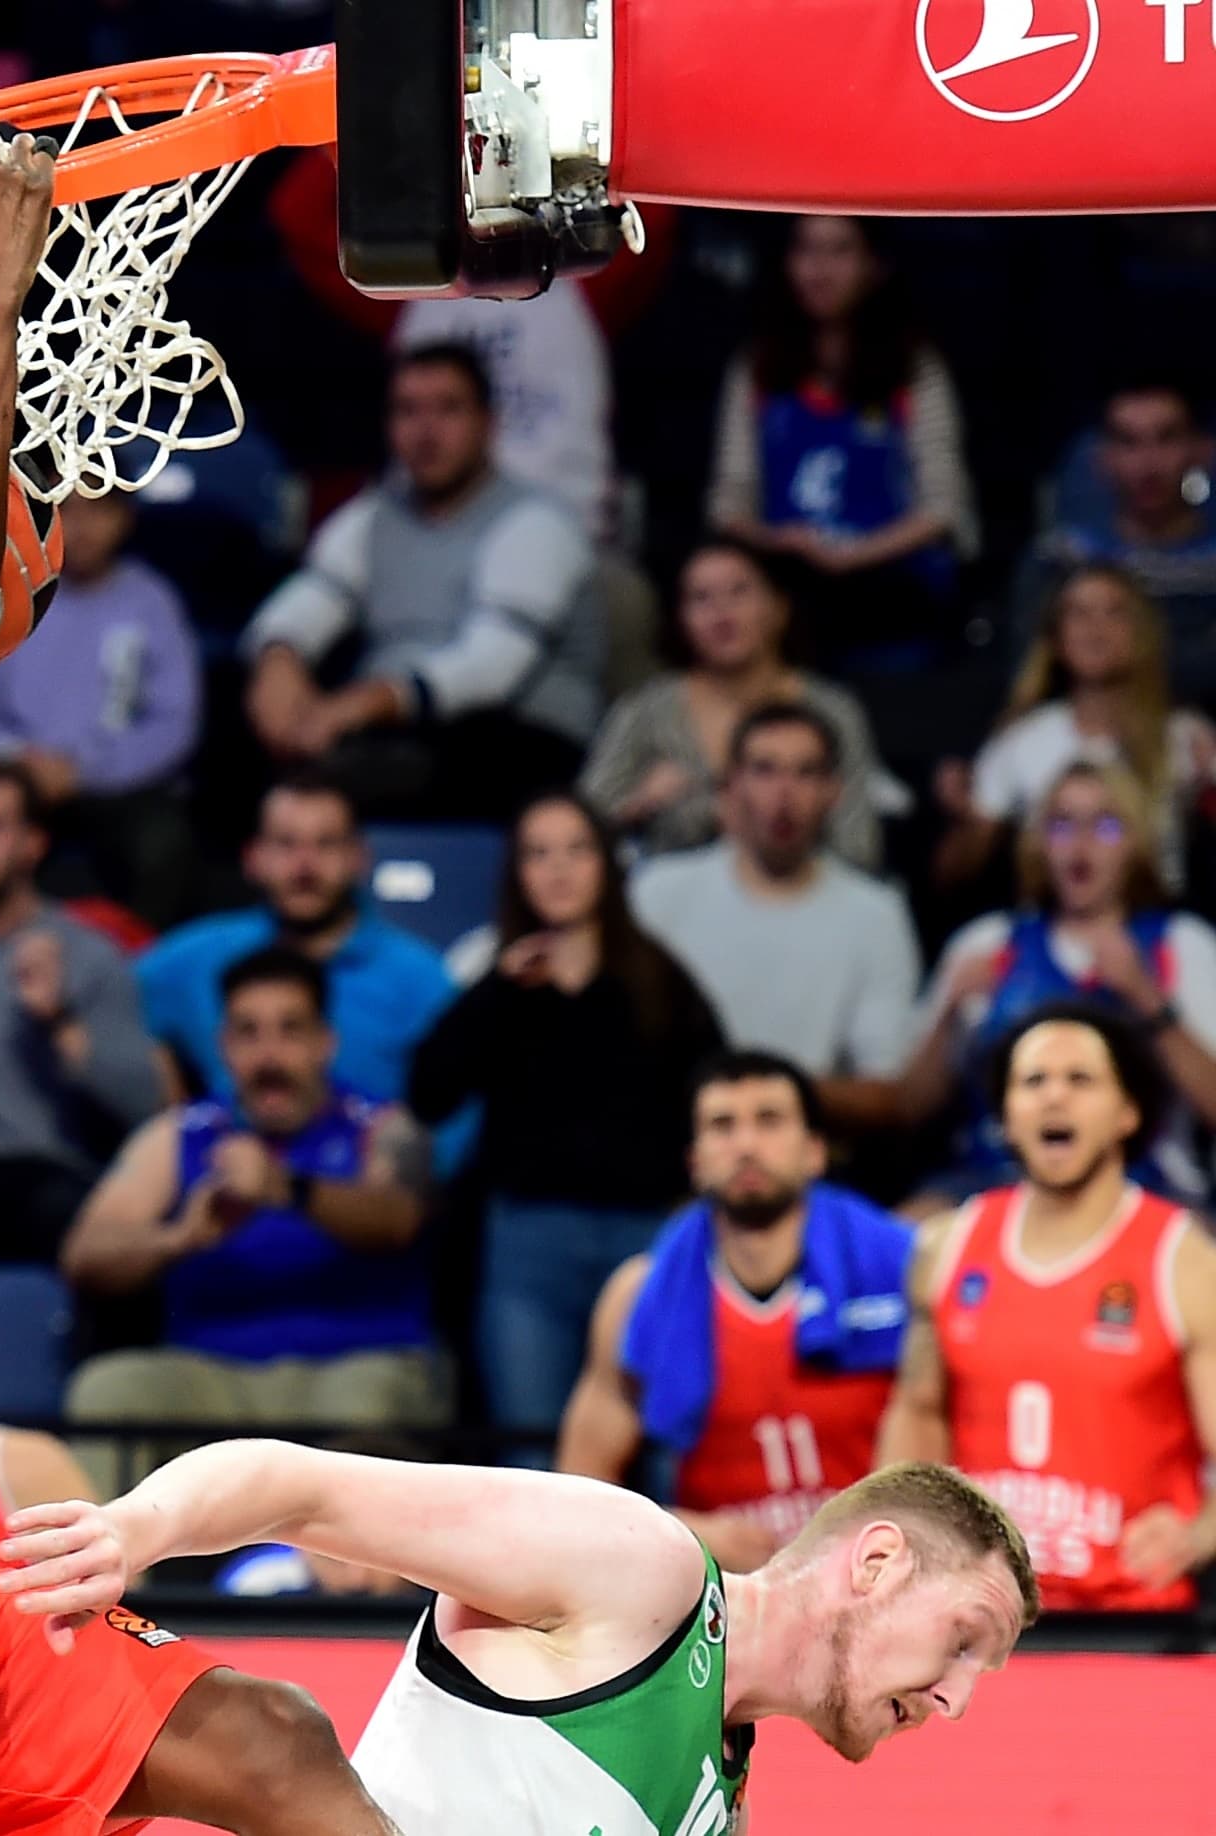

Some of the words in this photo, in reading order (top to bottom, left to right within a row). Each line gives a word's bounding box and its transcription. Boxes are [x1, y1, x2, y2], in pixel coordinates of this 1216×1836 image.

[1145, 0, 1216, 63] T
[754, 1413, 822, 1490] 11
[1008, 1380, 1052, 1469] 0
